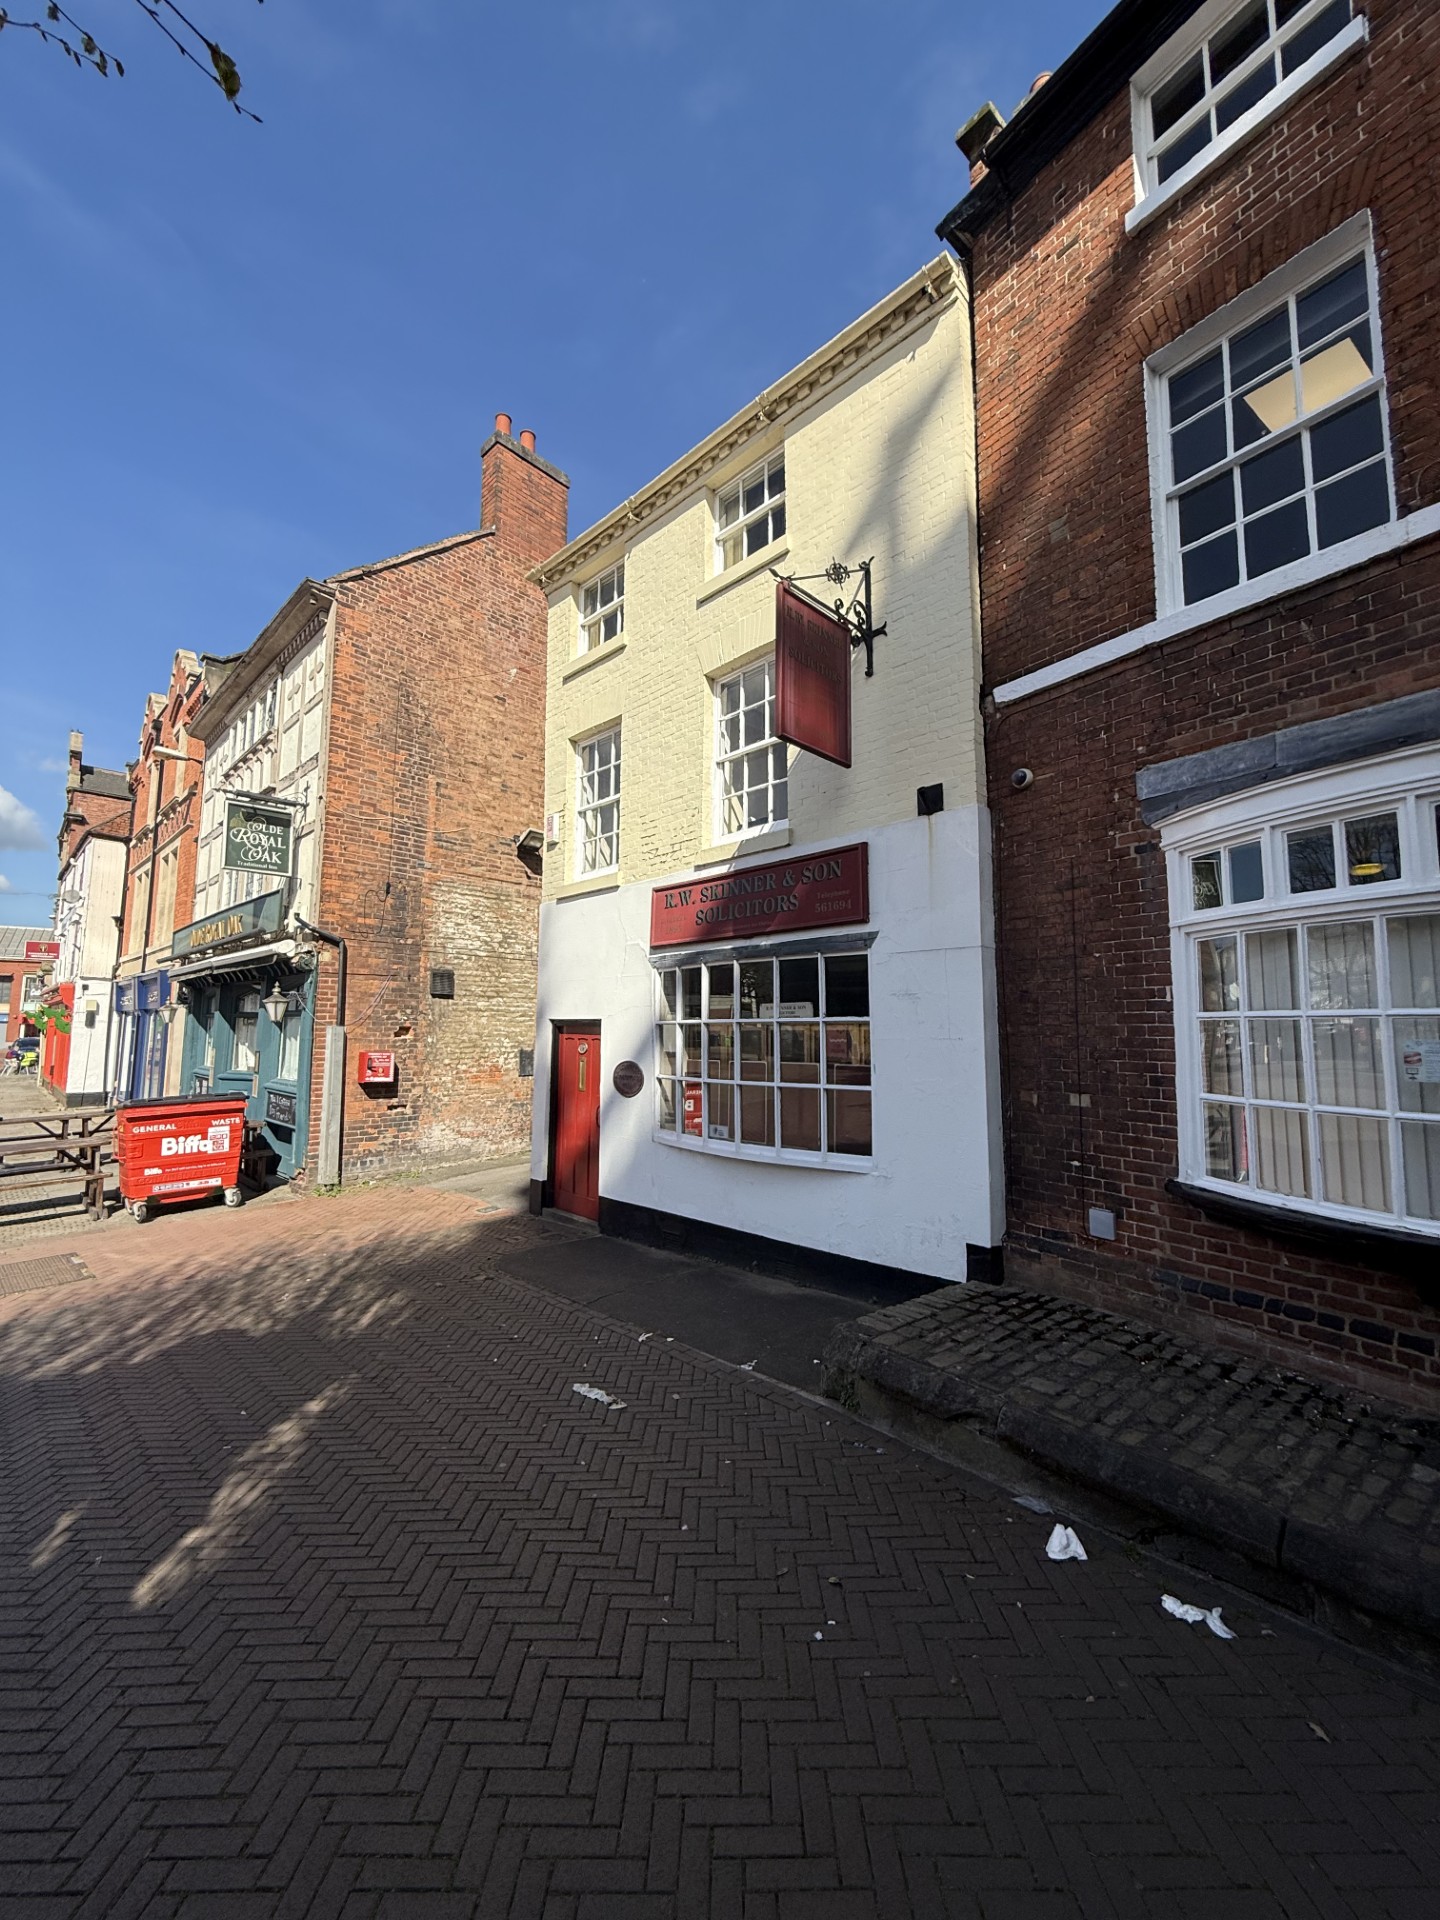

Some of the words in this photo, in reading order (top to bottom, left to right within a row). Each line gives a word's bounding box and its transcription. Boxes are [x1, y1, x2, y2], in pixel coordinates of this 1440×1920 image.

[789, 647, 843, 683] SOLICITORS
[247, 817, 284, 835] OLDE
[230, 827, 287, 850] ROYAL
[241, 846, 282, 864] OAK
[664, 889, 695, 909] R.W.
[700, 873, 777, 903] SKINNER
[783, 869, 796, 887] &
[802, 860, 842, 885] SON
[695, 893, 799, 926] SOLICITORS
[132, 1123, 177, 1134] GENERAL
[211, 1116, 241, 1127] WASTE
[161, 1134, 210, 1157] Biffa
